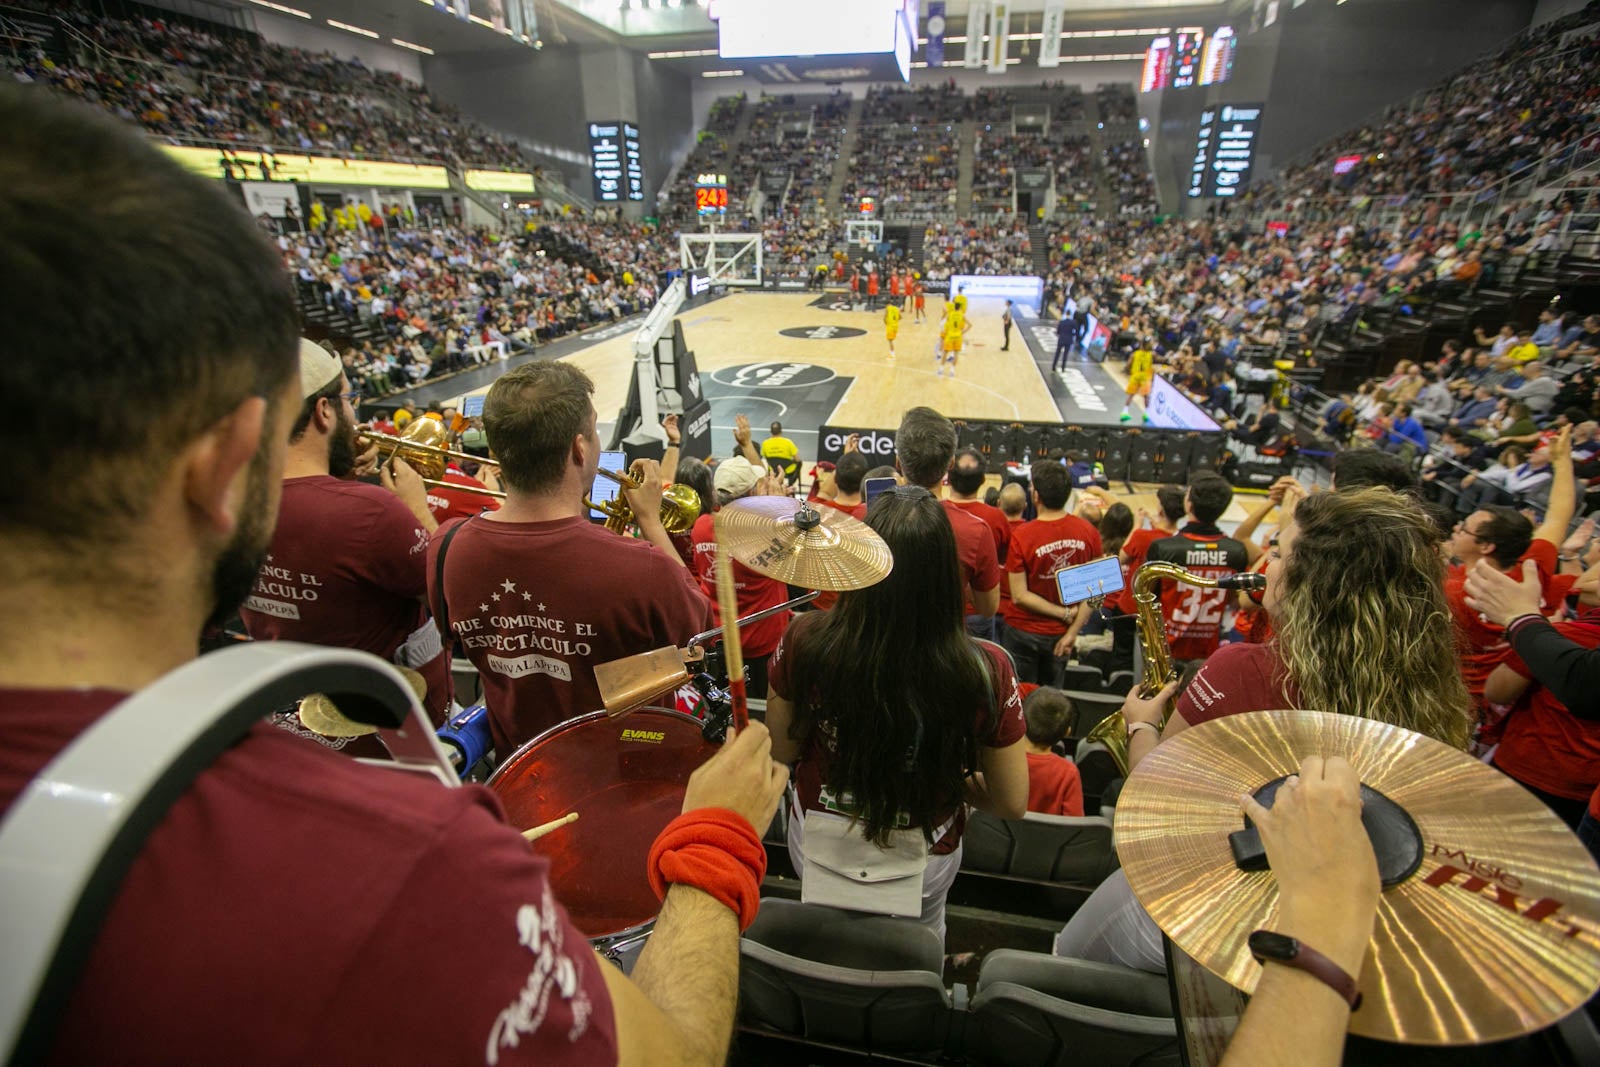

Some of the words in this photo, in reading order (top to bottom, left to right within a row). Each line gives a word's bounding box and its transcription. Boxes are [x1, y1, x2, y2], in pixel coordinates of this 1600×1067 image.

[696, 188, 717, 206] 24
[300, 572, 323, 587] EL
[1171, 580, 1227, 624] 32
[452, 617, 484, 636] QUE
[490, 614, 566, 634] COMIENCE
[575, 622, 598, 637] EL
[464, 631, 592, 657] ESPECTÁCULO
[621, 729, 665, 741] EVANS
